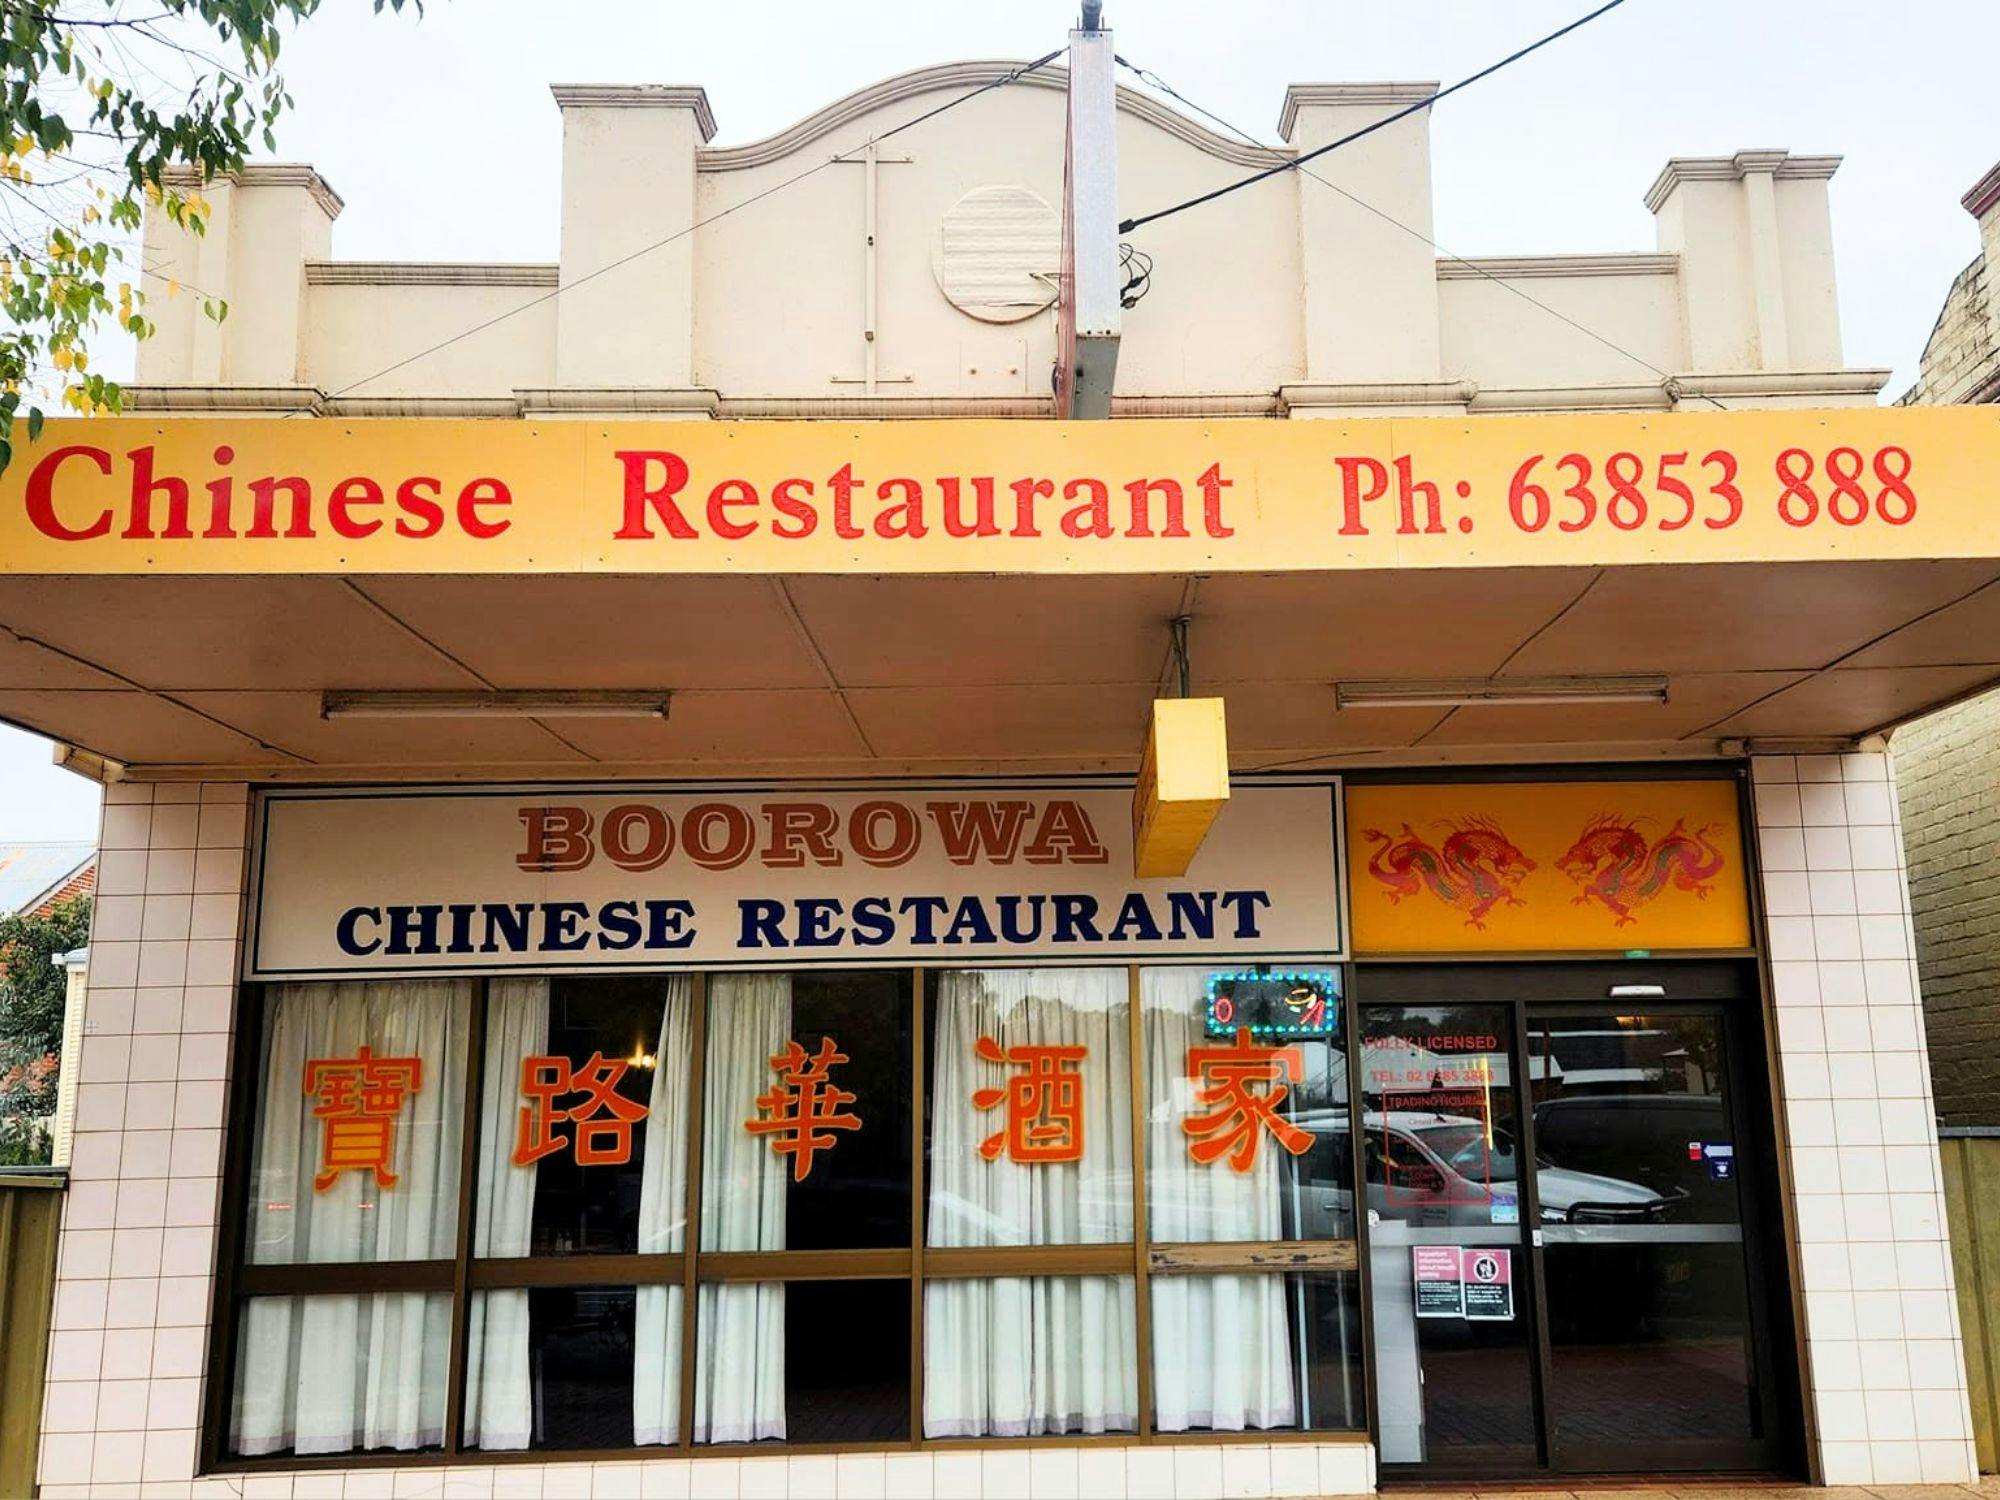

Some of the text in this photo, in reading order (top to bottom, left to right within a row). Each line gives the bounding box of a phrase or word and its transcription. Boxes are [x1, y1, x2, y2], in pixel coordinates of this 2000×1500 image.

[25, 445, 1918, 541] Chinese Restaurant Ph: 63853 888
[515, 800, 1110, 873] BOOROWA
[336, 890, 1271, 956] CHINESE RESTAURANT
[1417, 1034, 1498, 1050] LICENSED
[1406, 1069, 1421, 1083] 02
[1389, 1096, 1438, 1108] TRADING
